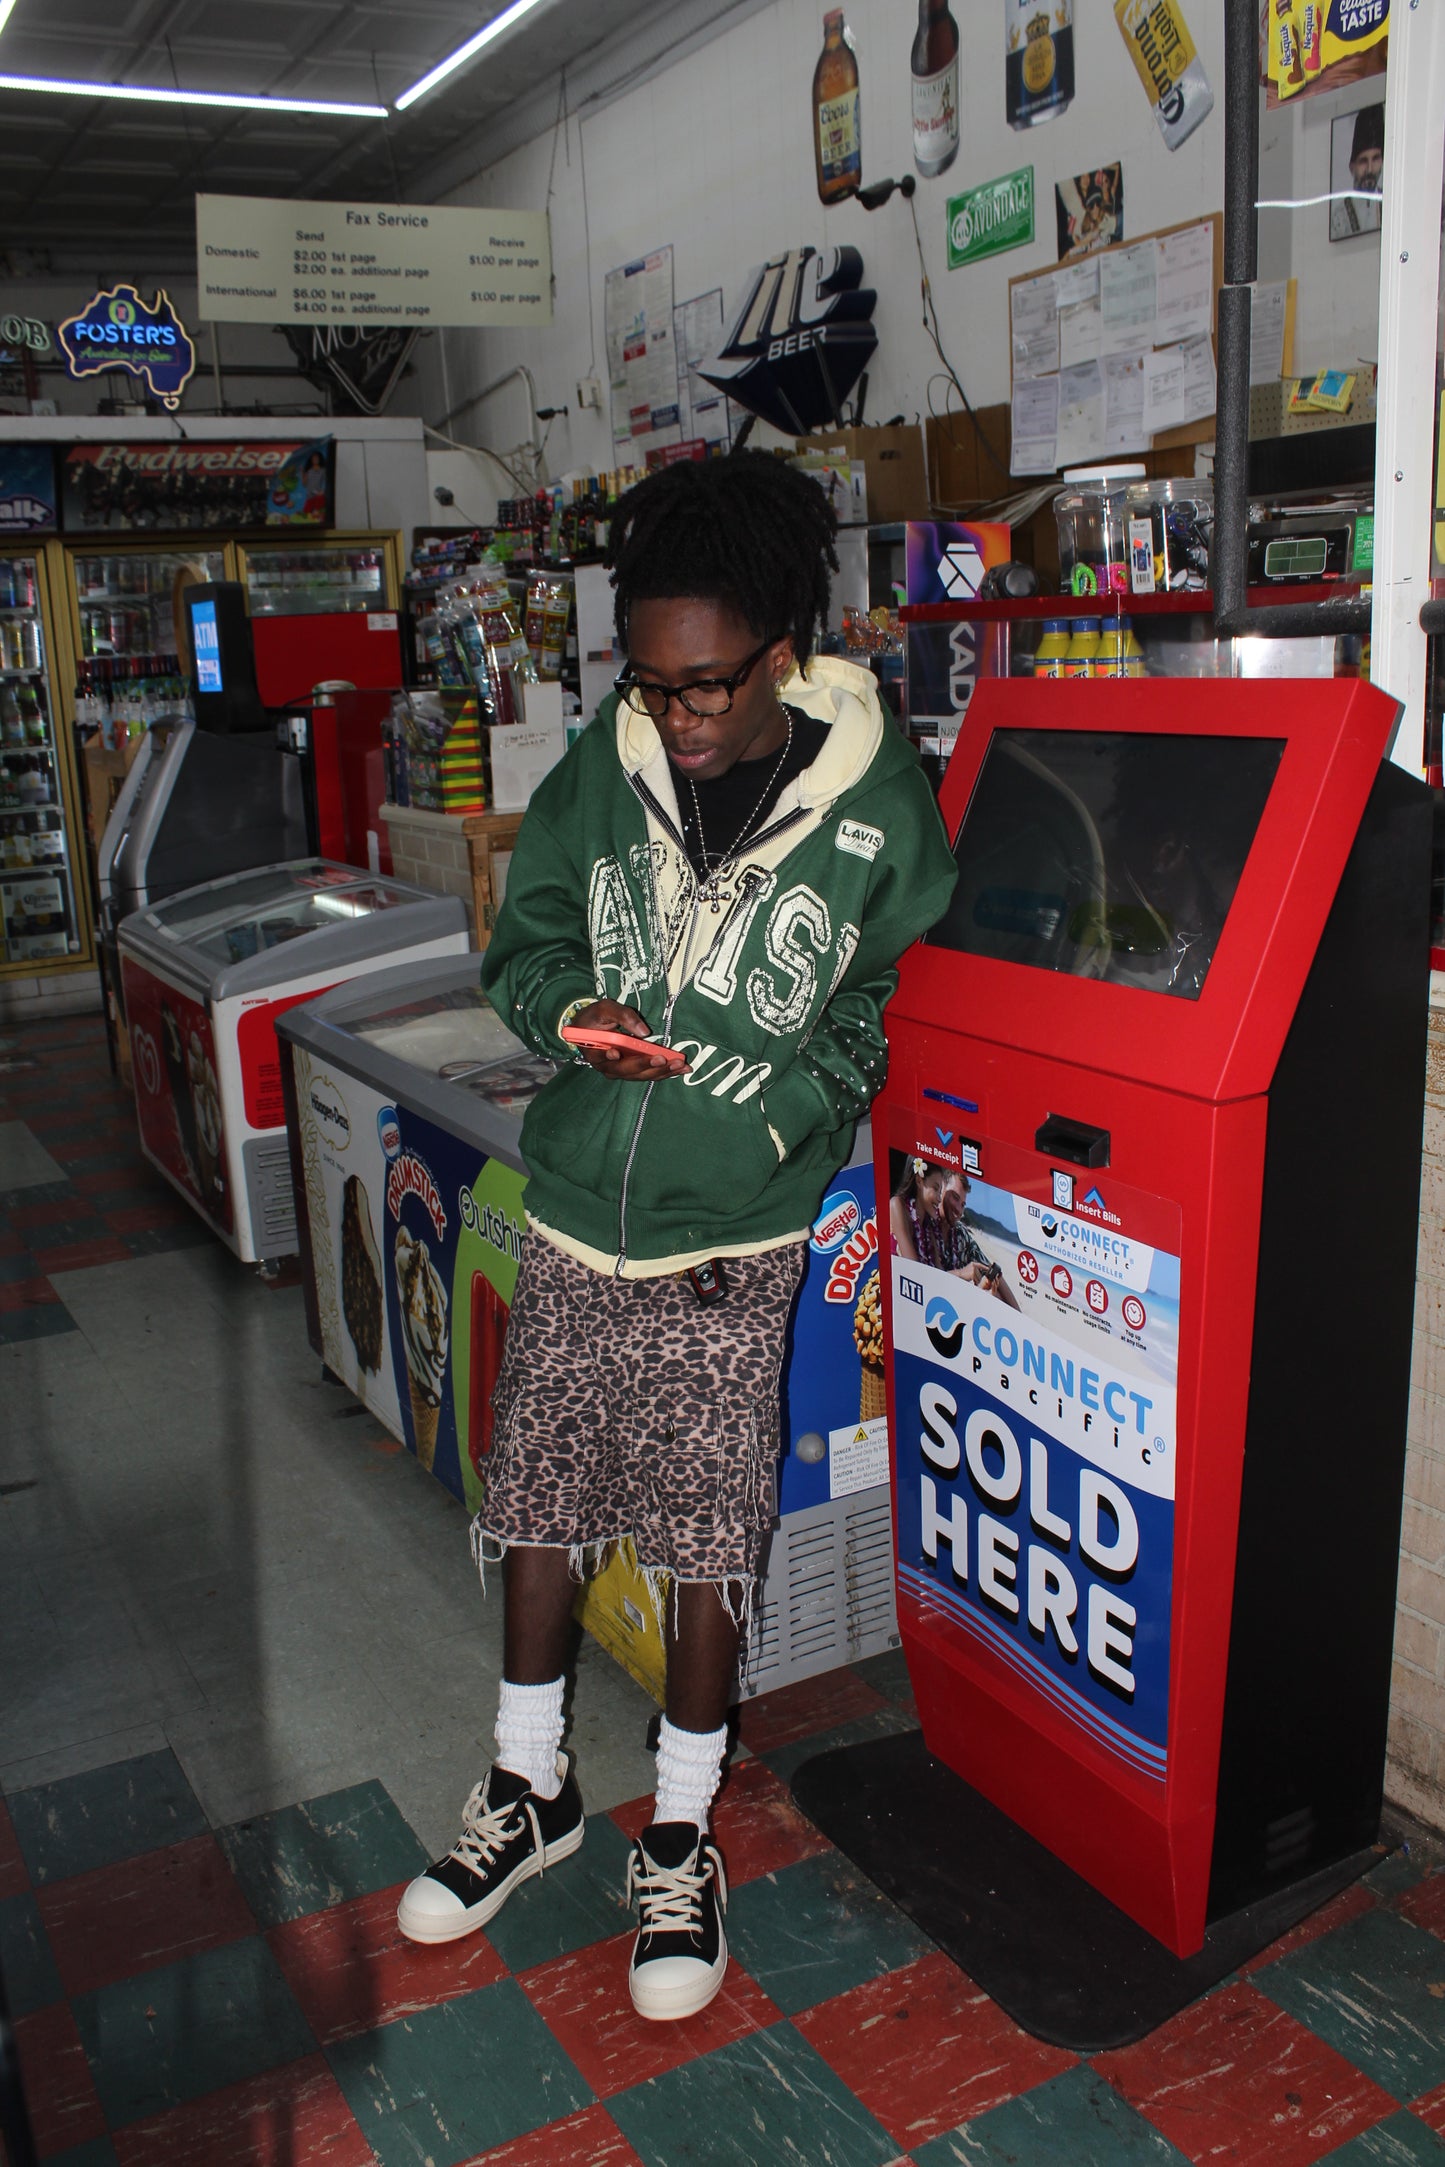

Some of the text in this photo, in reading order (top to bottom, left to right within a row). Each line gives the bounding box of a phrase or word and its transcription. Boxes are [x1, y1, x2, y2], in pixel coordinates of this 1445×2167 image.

[1304, 4, 1314, 49] Nesquik
[1341, 1, 1382, 33] TASTE
[1280, 24, 1292, 66] Nesquik
[1135, 17, 1185, 124] Corona
[821, 102, 849, 125] Coors
[823, 142, 850, 160] BEER
[346, 211, 428, 228] Fax Service
[974, 178, 1028, 239] AVONDALE
[296, 231, 525, 248] Send Receive
[205, 246, 540, 268] Domestic $2.00 1st page $1.00 per page
[294, 264, 326, 275] $2.00
[352, 266, 401, 276] additional
[405, 269, 430, 279] page
[206, 284, 542, 304] International $6.00 1st page $1.00 per page
[294, 302, 327, 313] $4.00
[352, 304, 402, 315] additional
[406, 306, 430, 316] page
[74, 322, 176, 346] FOSTER'S
[768, 326, 828, 362] BEER
[94, 446, 292, 470] Budweiser
[194, 622, 218, 649] ATM
[842, 825, 881, 848] LAVIS
[916, 1141, 960, 1164] Take Receipt
[388, 1155, 447, 1242] DRUMSTICK
[1076, 1201, 1122, 1226] Insert Bills
[814, 1204, 858, 1247] Nestlé
[1061, 1220, 1130, 1258] CONNECT
[1044, 1242, 1124, 1280] AUTHORIZED RESELLER
[1024, 1290, 1033, 1299] fees
[1025, 1284, 1038, 1294] setup
[1052, 1296, 1079, 1312] maintenance
[1056, 1306, 1066, 1314] fees
[1083, 1319, 1110, 1334] usage limits
[1125, 1329, 1134, 1338] Top
[1127, 1338, 1135, 1347] any
[1136, 1341, 1146, 1351] time
[972, 1317, 1152, 1434] CONNECT
[833, 1446, 851, 1456] DANGER
[834, 1470, 852, 1479] CAUTION
[919, 1382, 1139, 1578] SOLD
[920, 1474, 1137, 1696] HERE
